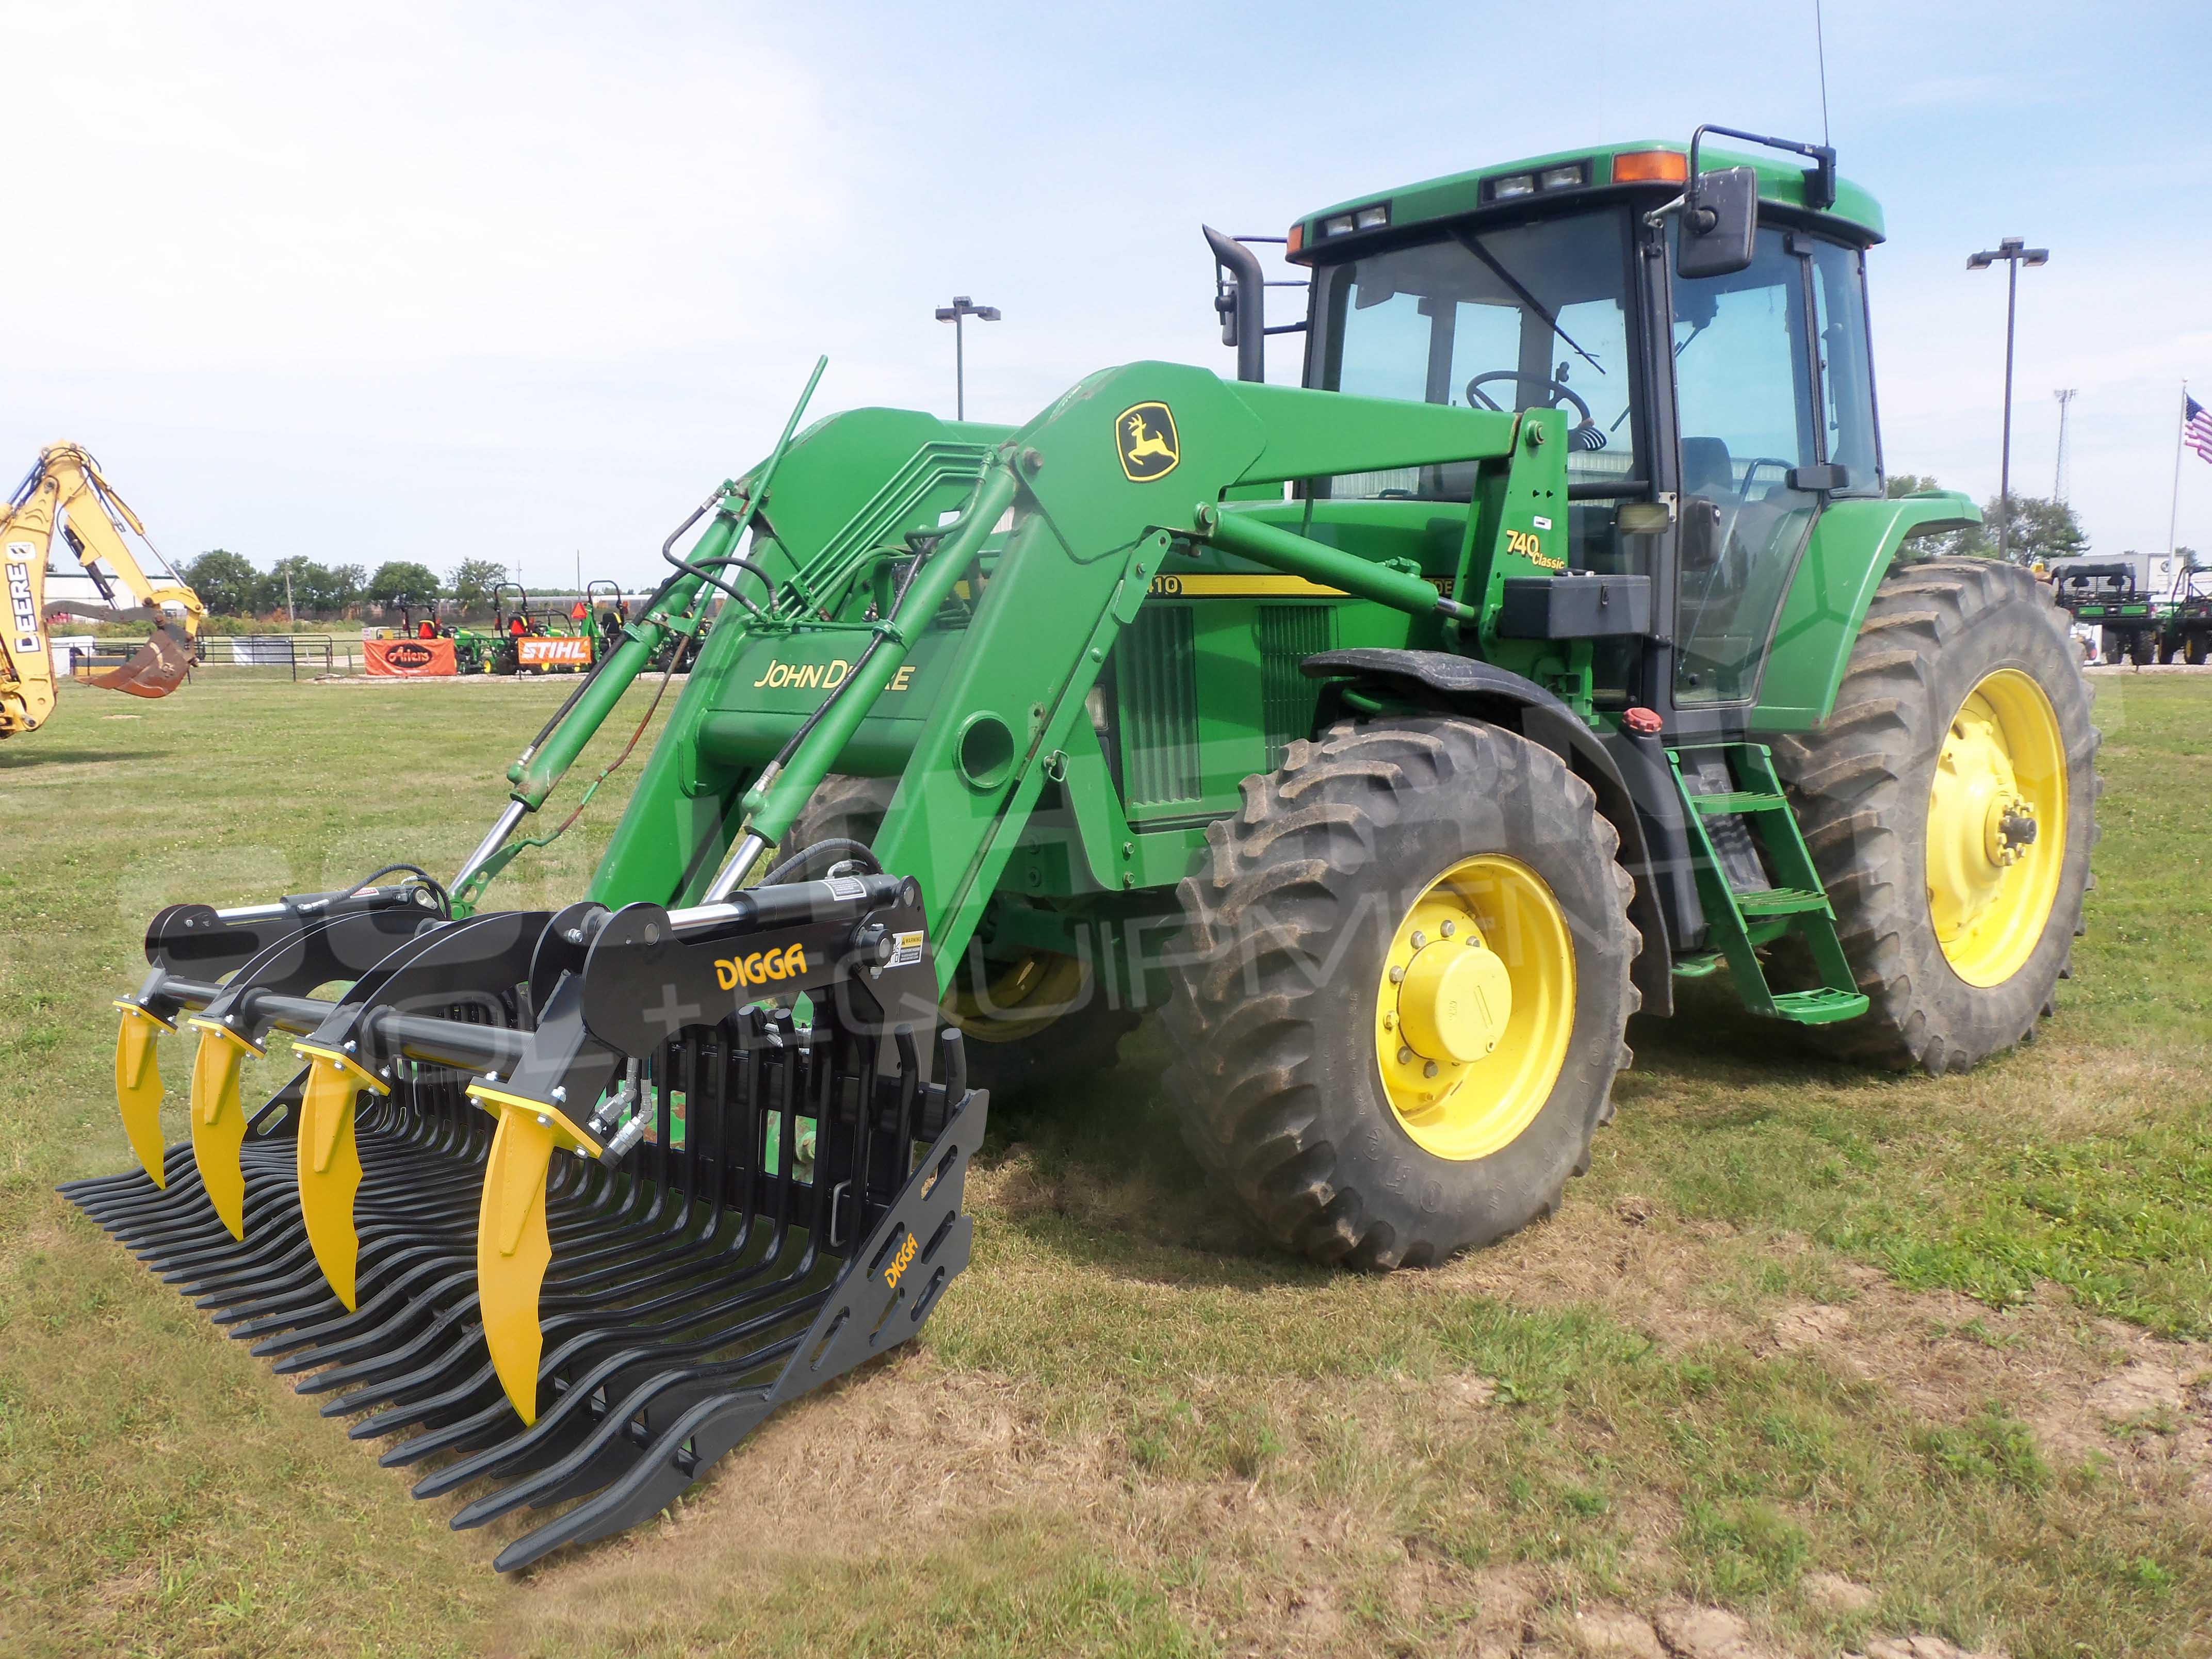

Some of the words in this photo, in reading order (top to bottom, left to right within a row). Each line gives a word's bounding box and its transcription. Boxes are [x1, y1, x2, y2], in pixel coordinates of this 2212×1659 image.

[1506, 530, 1540, 557] 740
[1532, 551, 1565, 570] Classic
[5, 562, 41, 654] DEERE
[388, 646, 430, 662] Ariens
[521, 641, 586, 659] STIHL
[754, 659, 824, 688] JOHN
[713, 943, 808, 991] DIGGA
[884, 1232, 919, 1289] DIGGA
